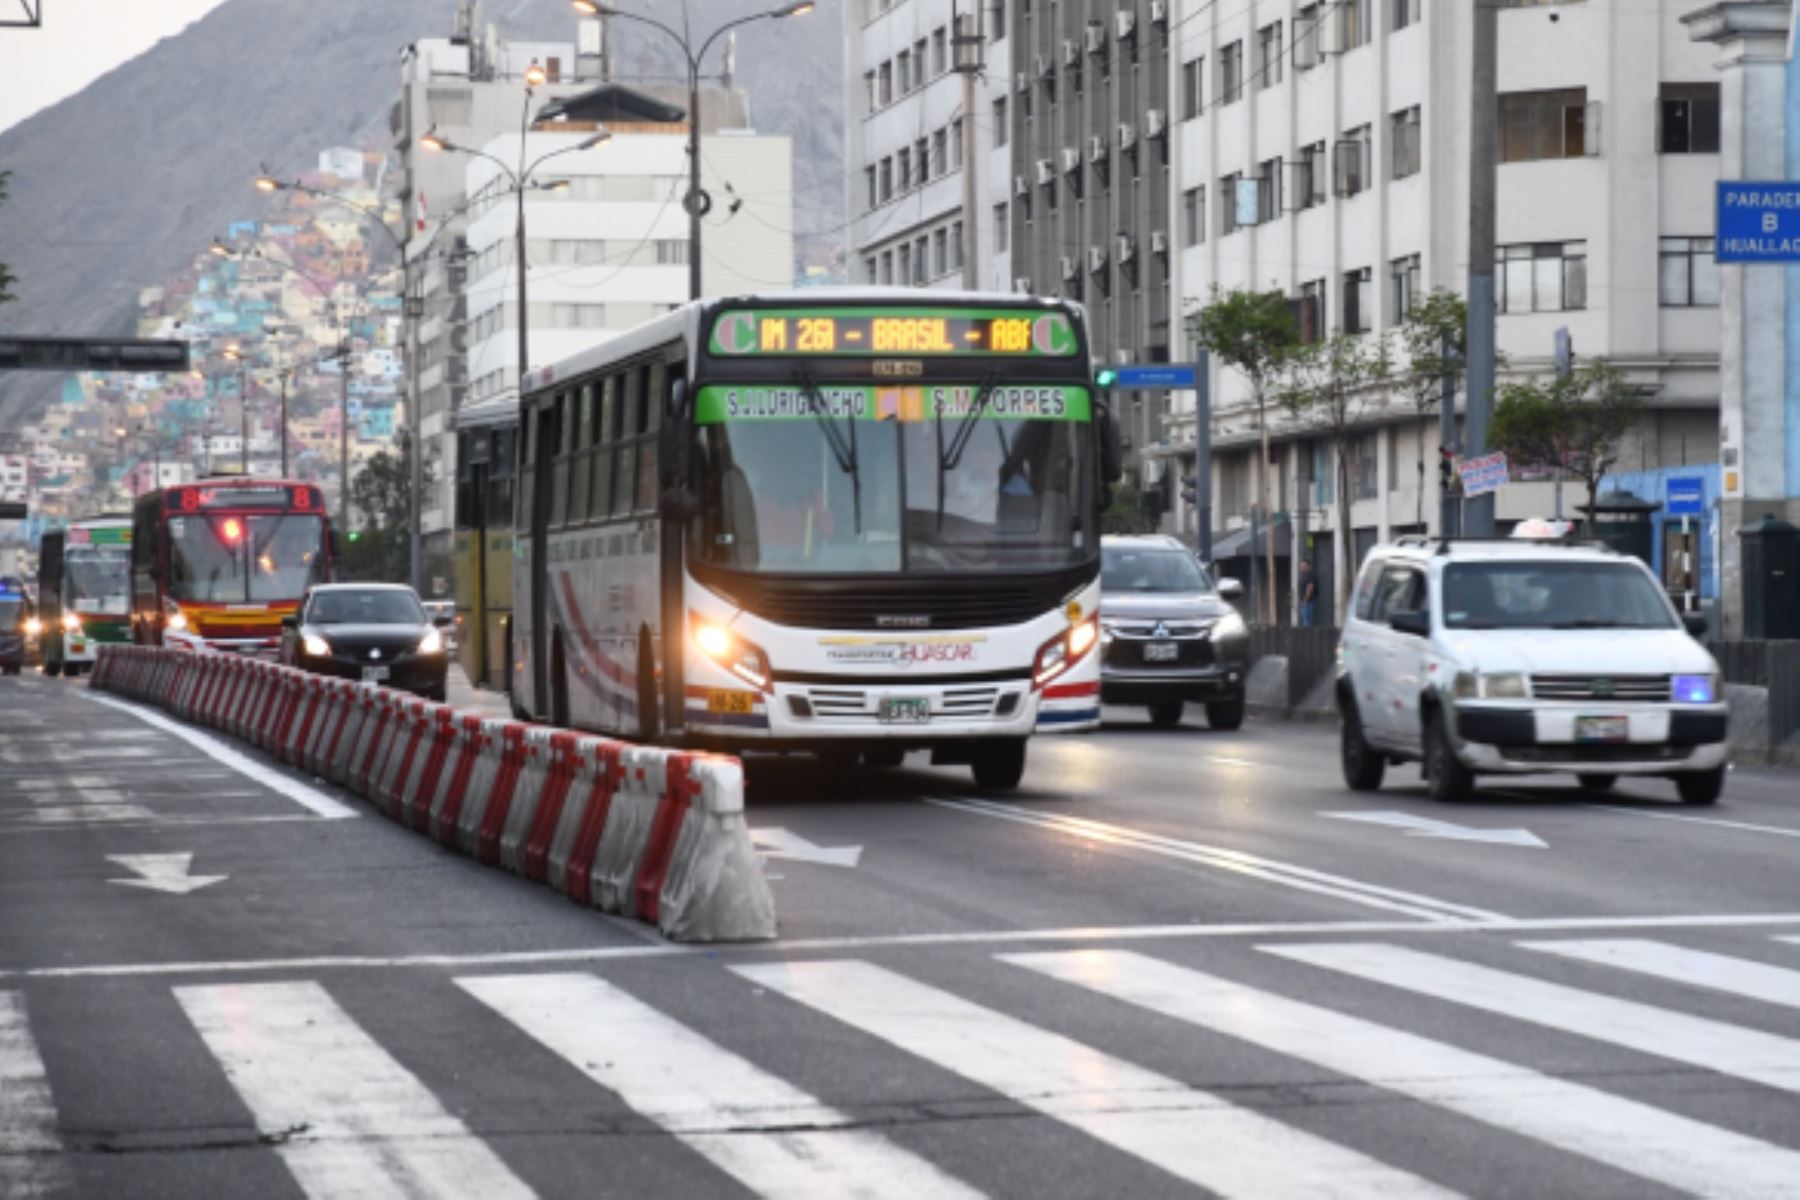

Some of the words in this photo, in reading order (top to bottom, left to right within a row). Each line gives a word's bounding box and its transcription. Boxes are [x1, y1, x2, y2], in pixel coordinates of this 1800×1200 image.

[1761, 212, 1779, 233] B
[872, 317, 954, 351] BRASIL
[932, 387, 1066, 416] S.M.ORRES
